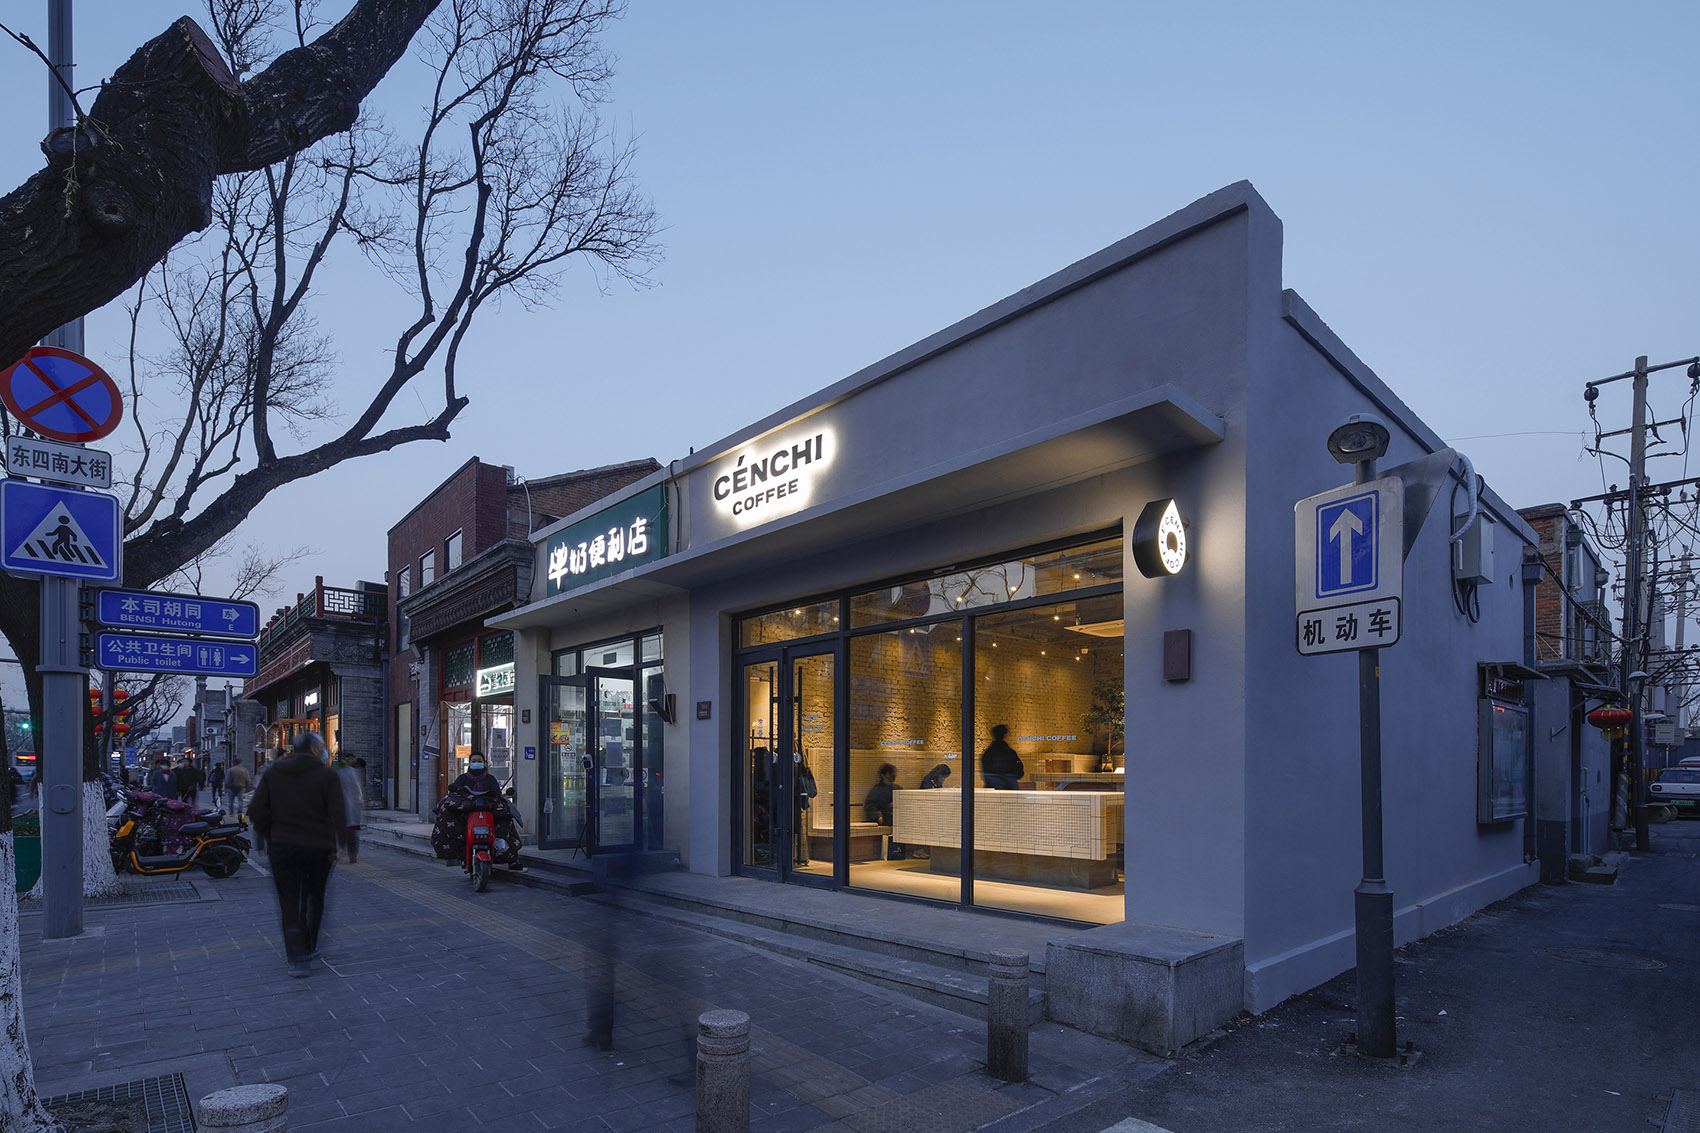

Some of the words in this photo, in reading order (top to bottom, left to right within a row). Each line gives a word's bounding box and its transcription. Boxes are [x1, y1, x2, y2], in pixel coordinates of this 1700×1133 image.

[12, 445, 107, 480] 东四南大街
[714, 433, 823, 501] CÉNCHI
[732, 478, 799, 516] COFFEE
[120, 614, 155, 624] BENSI
[162, 617, 202, 629] Hutong
[121, 597, 202, 619] 本司胡同
[1303, 608, 1392, 647] 机动车
[107, 639, 192, 658] 公共卫生间
[118, 655, 150, 665] Public
[155, 657, 182, 667] toilet
